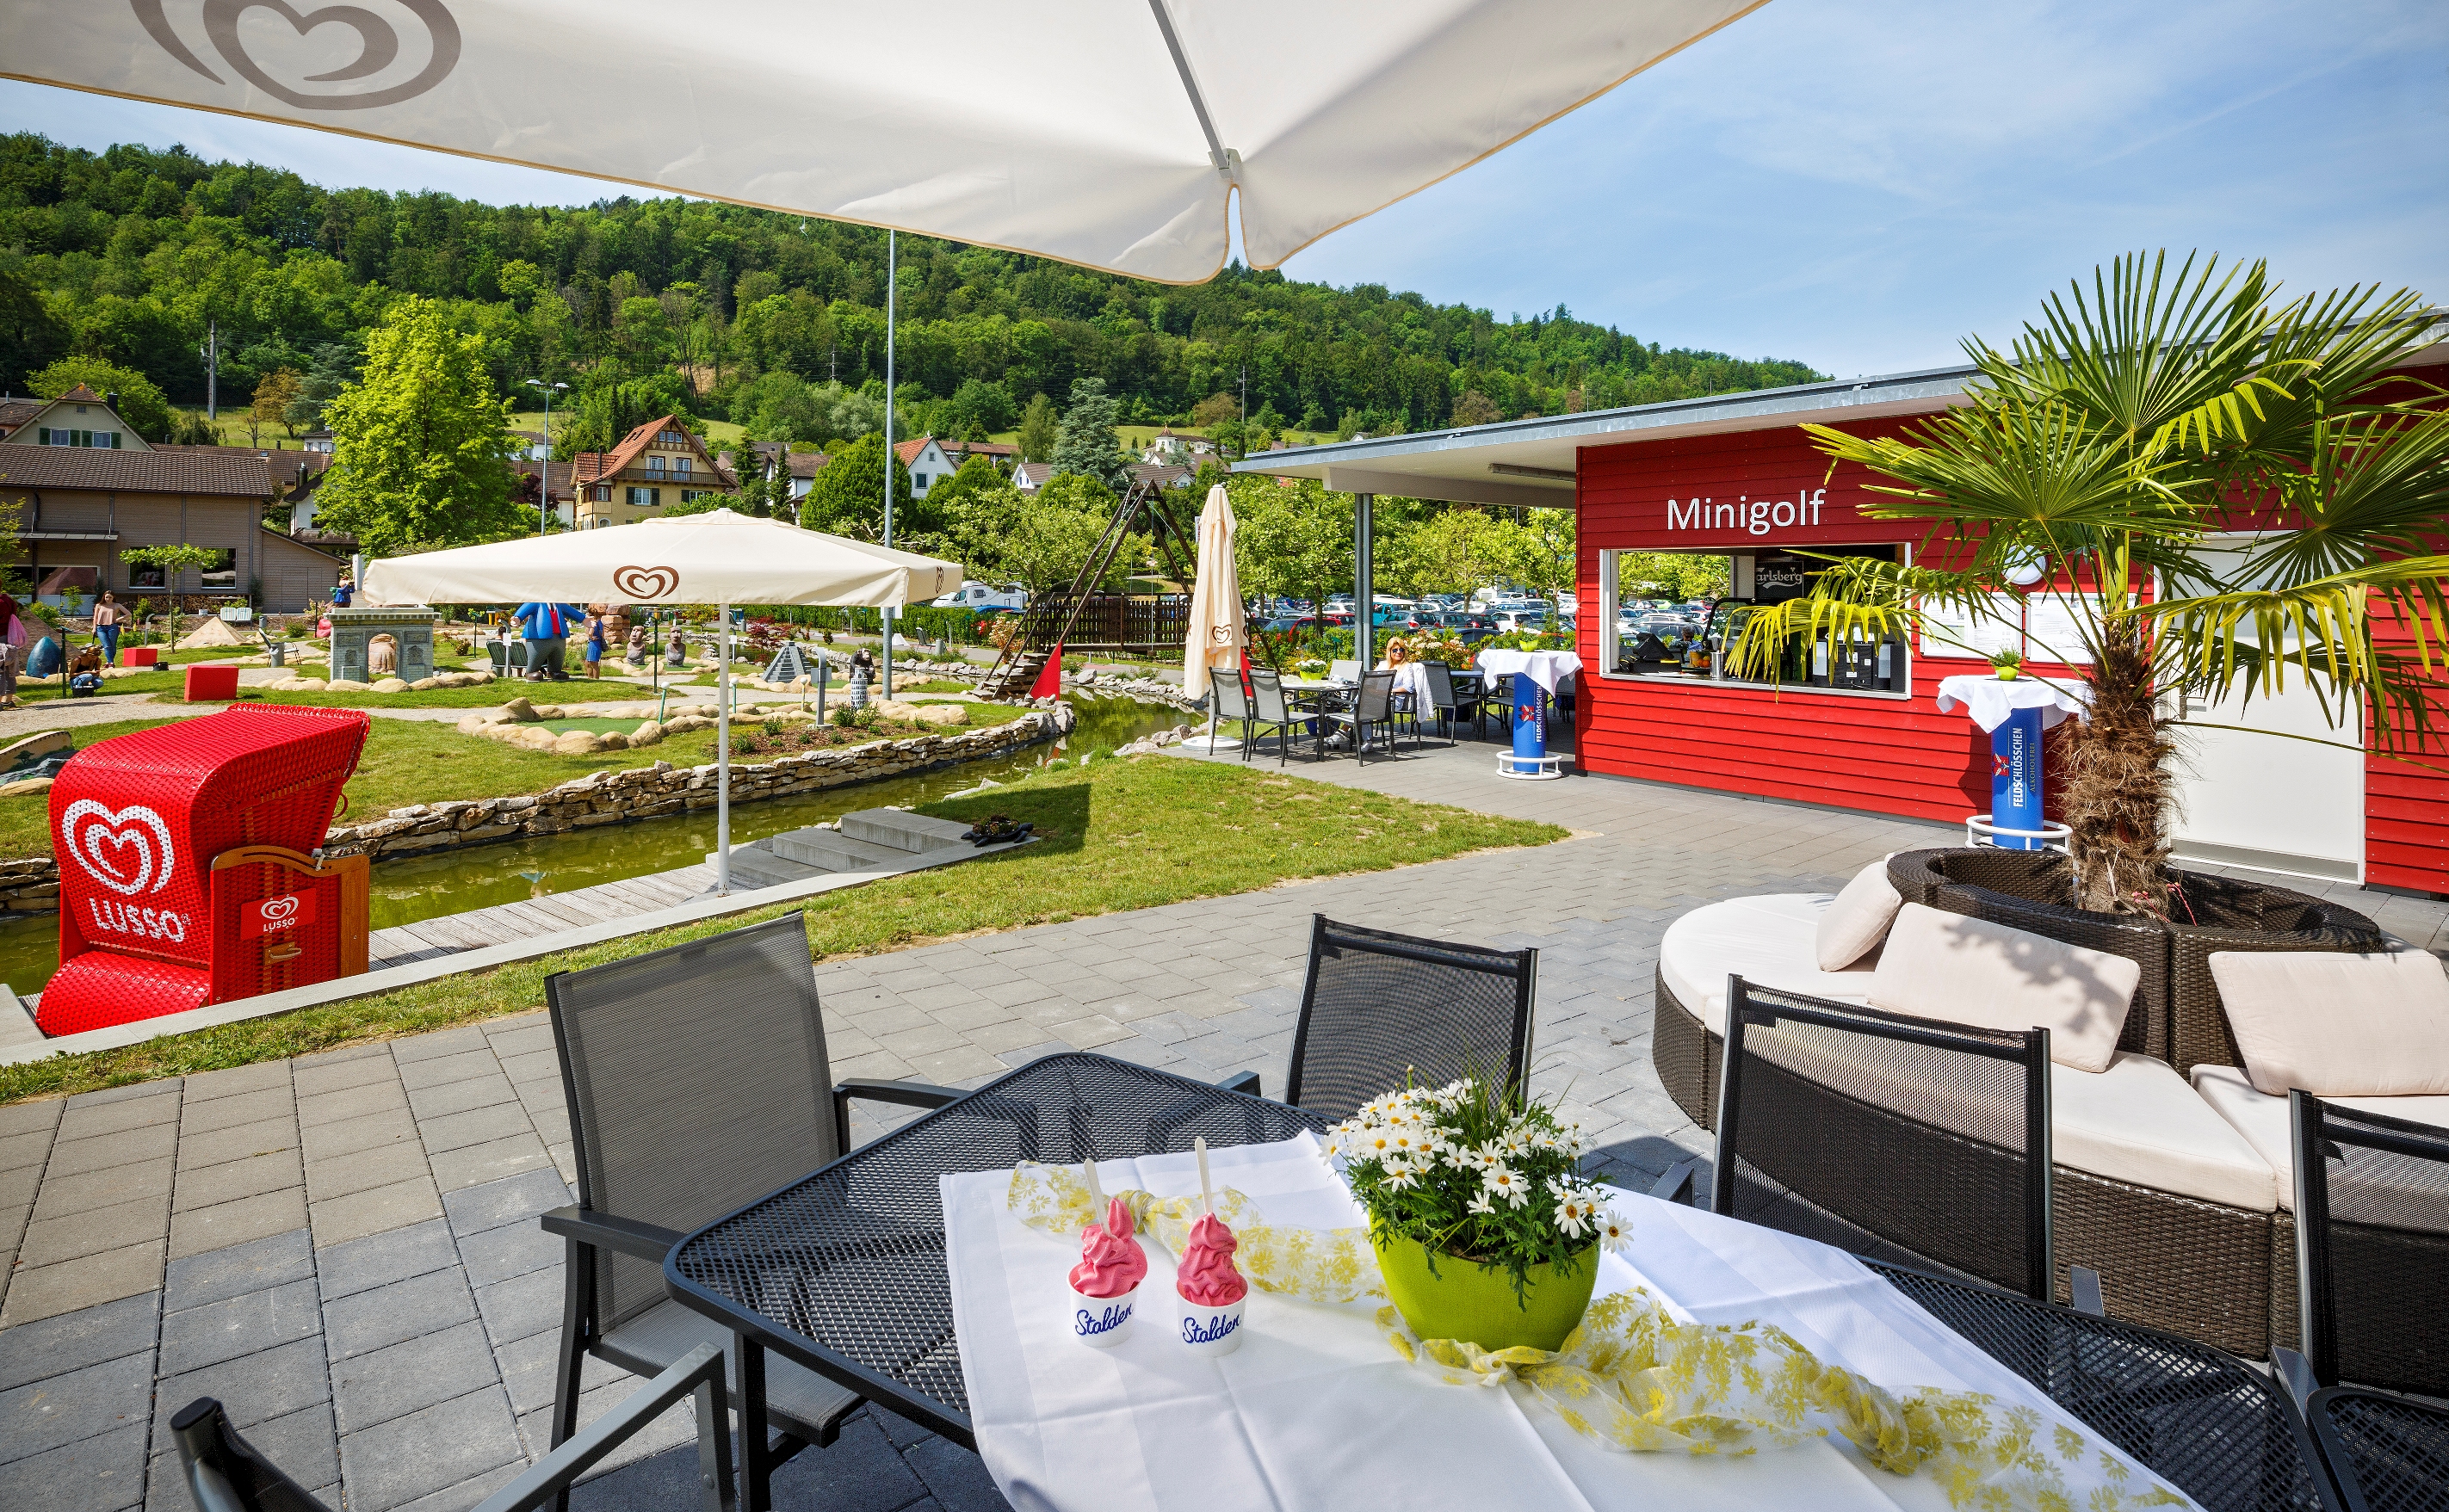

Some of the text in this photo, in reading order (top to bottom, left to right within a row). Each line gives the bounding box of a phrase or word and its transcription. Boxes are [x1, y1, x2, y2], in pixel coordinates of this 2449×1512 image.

[1667, 489, 1827, 535] Minigolf
[2011, 727, 2024, 807] FELDSCHLÖSSCHEN
[1075, 1303, 1132, 1336] Stalder
[1182, 1314, 1240, 1344] Stalder
